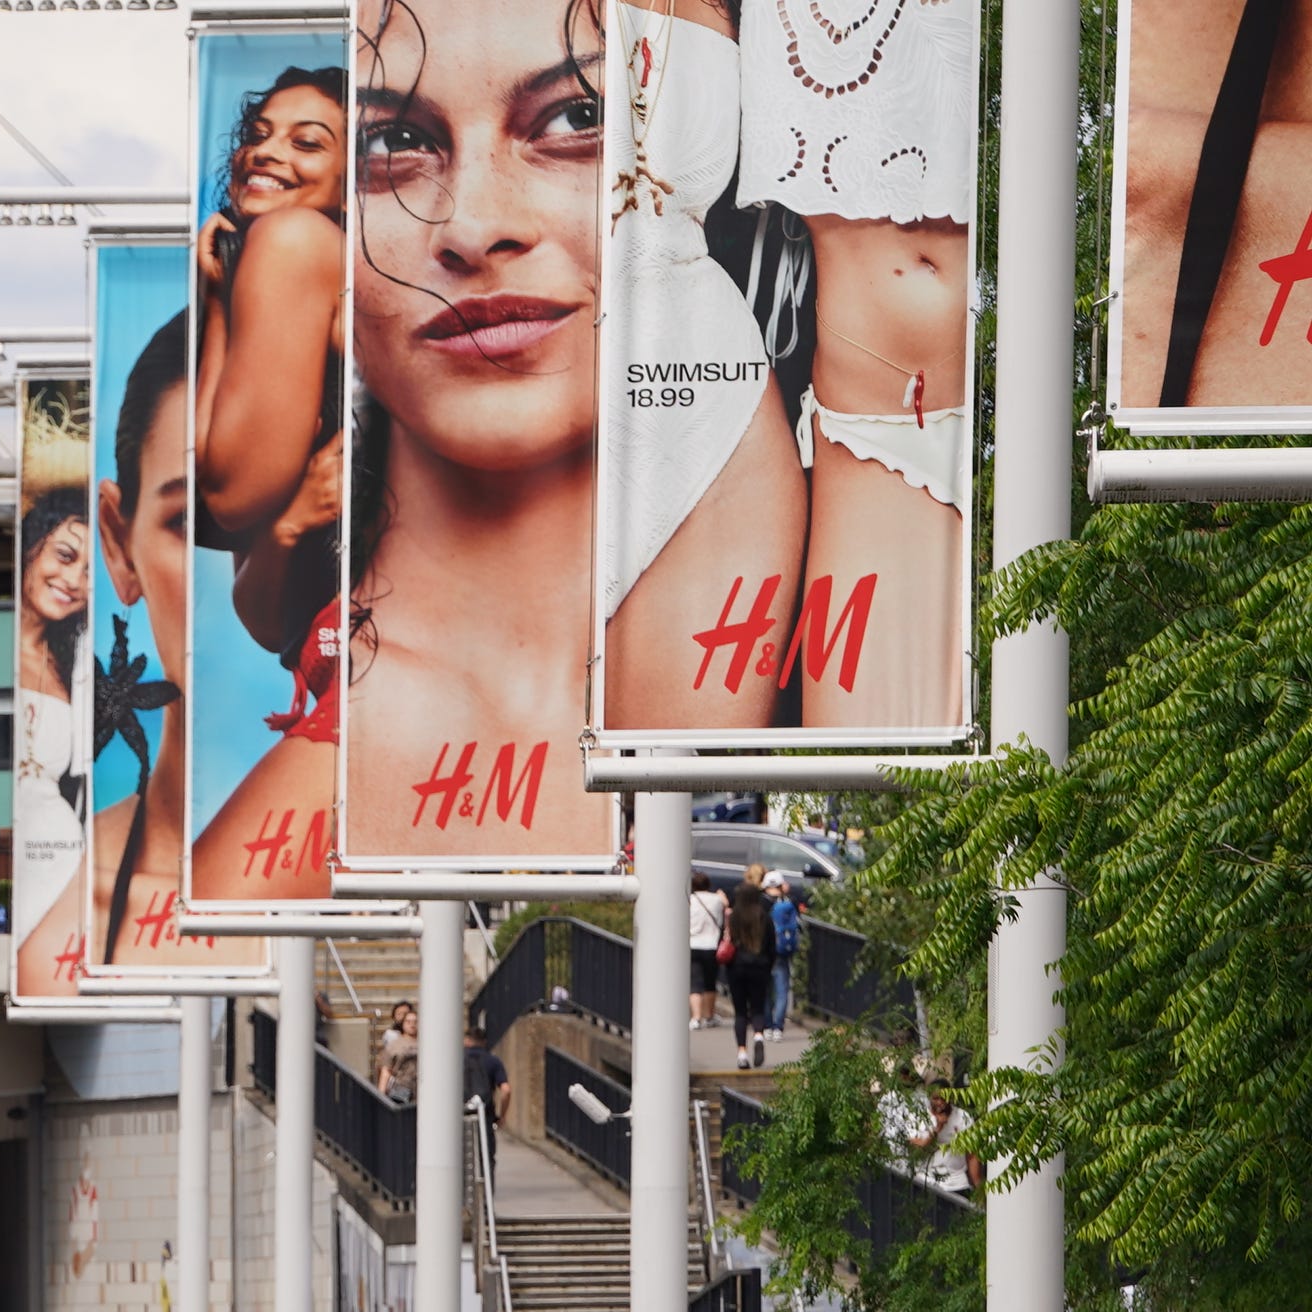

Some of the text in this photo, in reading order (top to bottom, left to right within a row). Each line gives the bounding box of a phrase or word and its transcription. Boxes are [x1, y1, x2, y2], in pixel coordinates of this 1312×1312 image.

[626, 361, 766, 383] SWIMSUIT
[626, 387, 696, 408] 18.99
[691, 572, 879, 695] H&M
[412, 741, 549, 830] H&M
